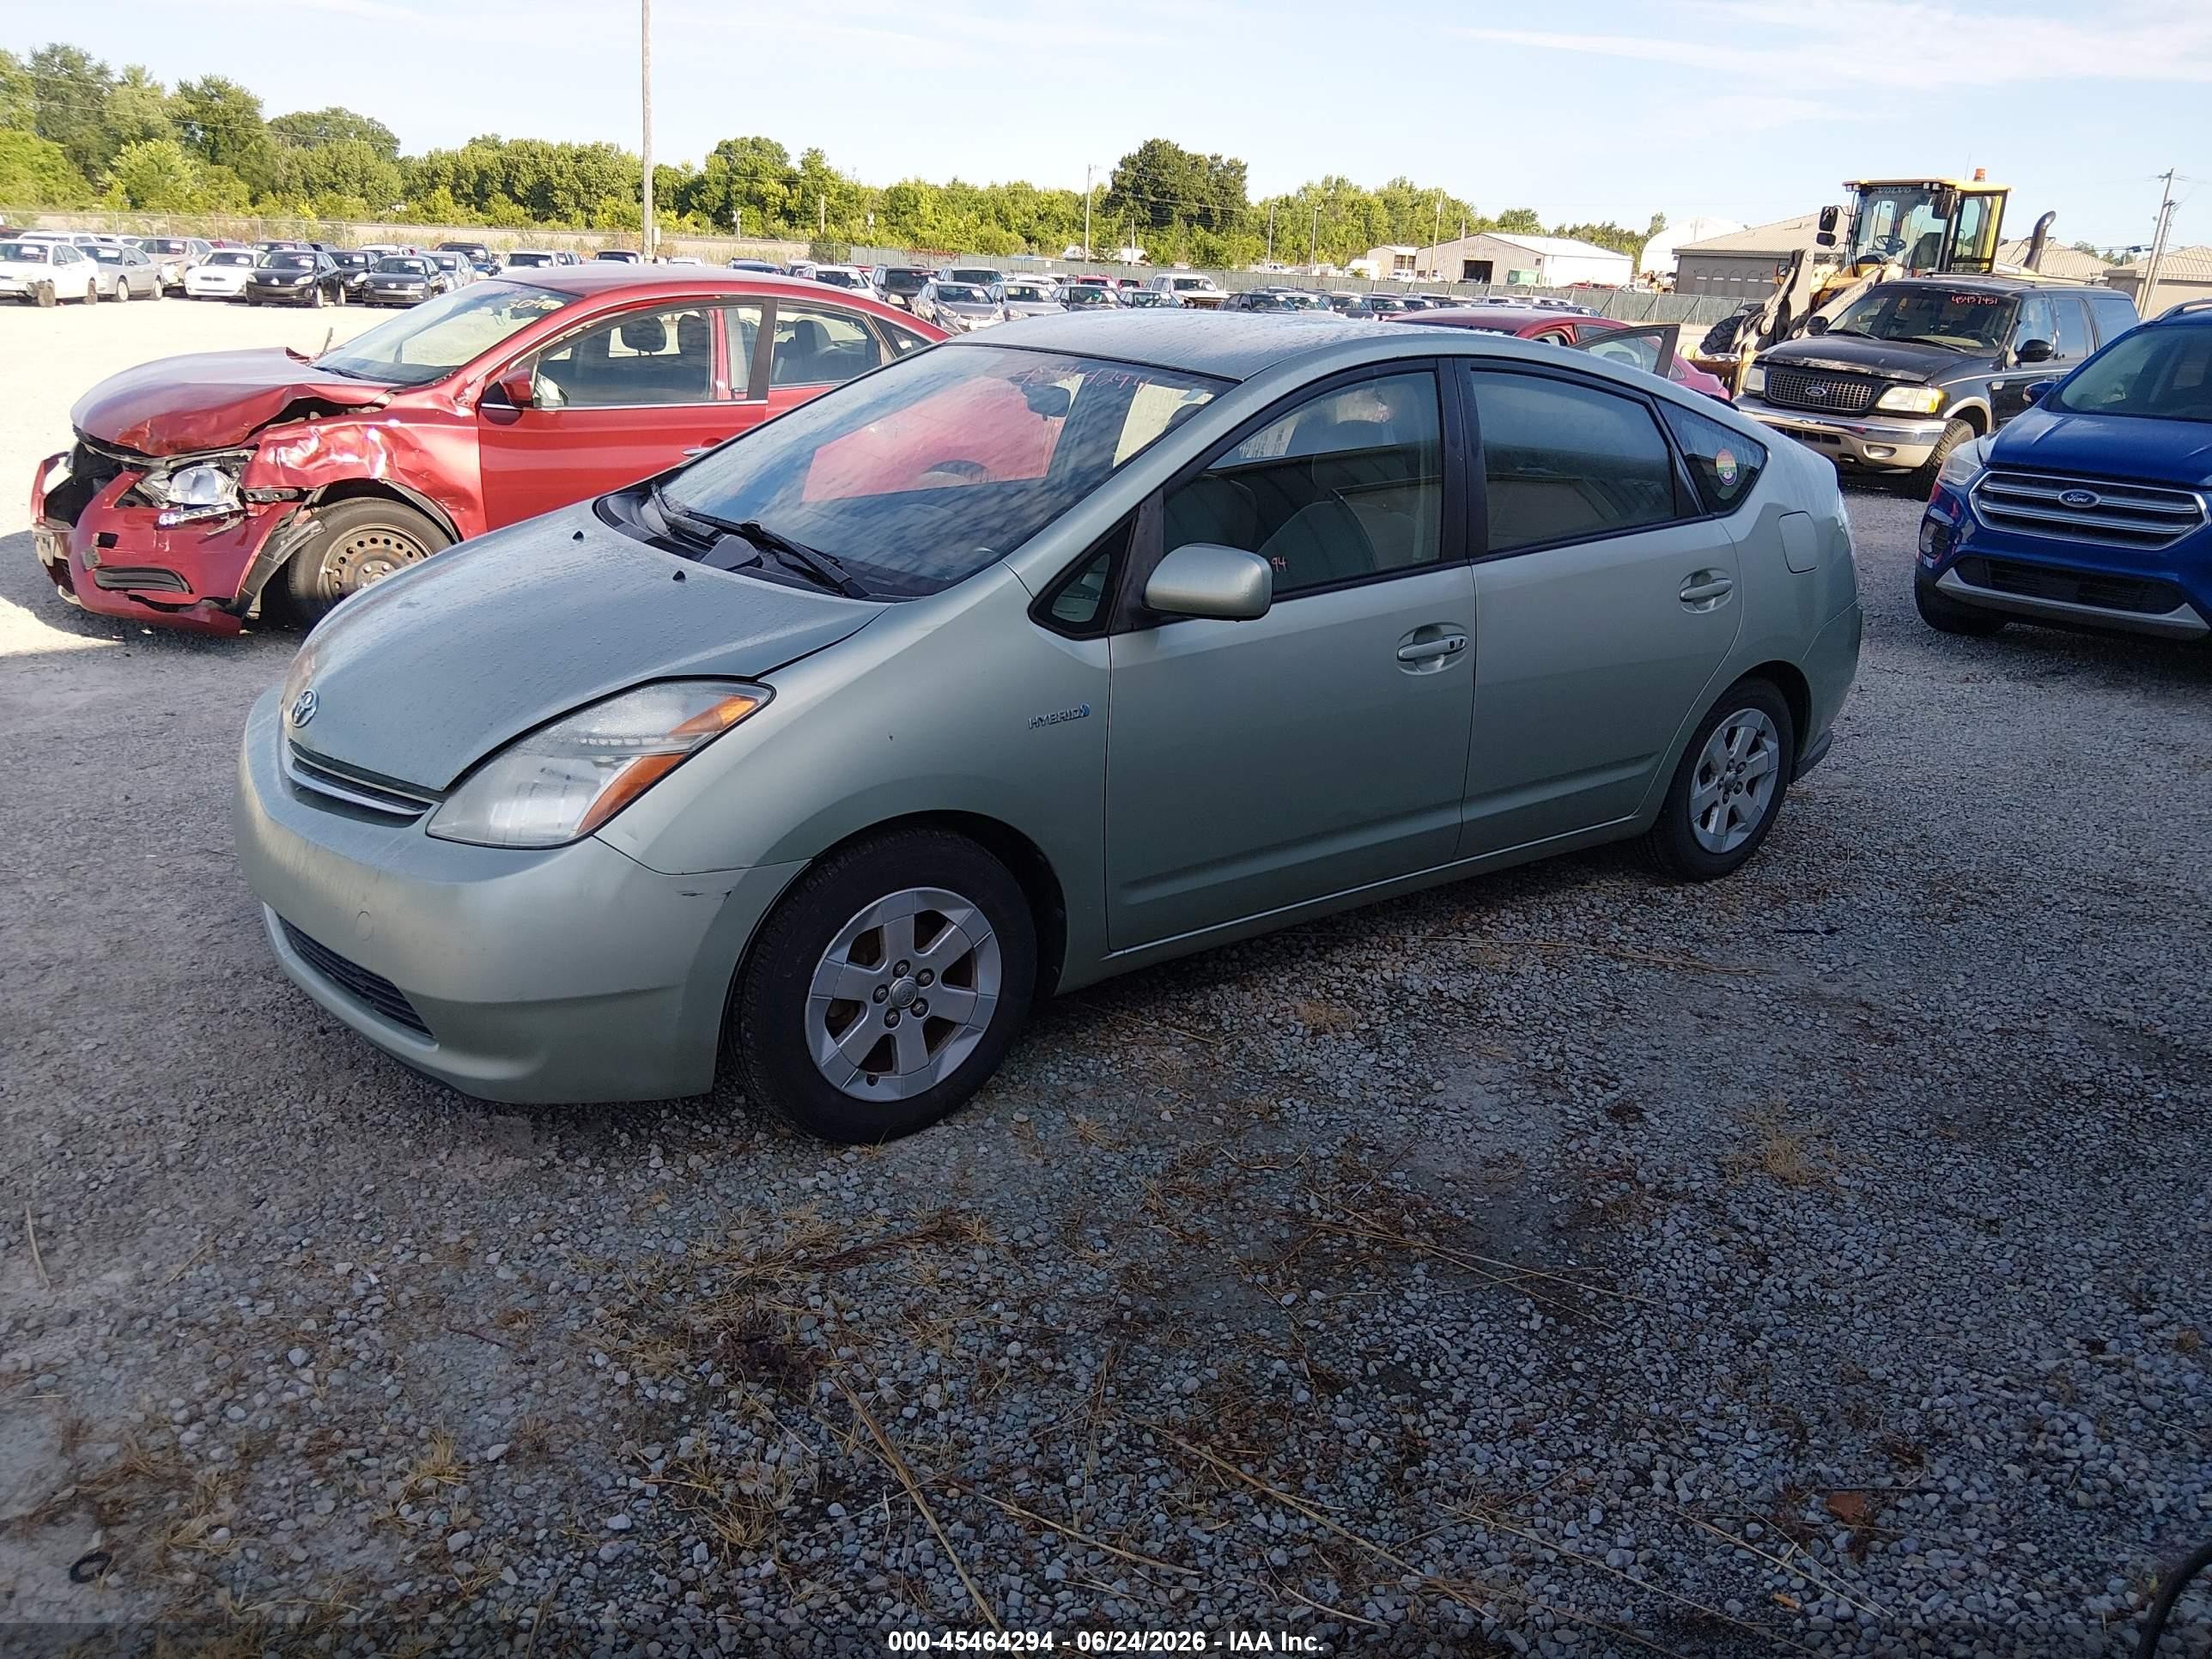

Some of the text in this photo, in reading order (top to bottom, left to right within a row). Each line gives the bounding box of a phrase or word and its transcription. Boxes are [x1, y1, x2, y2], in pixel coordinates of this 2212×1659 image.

[1877, 185, 1911, 194] VOLVO
[2067, 493, 2090, 503] Ford
[1271, 556, 1286, 572] 94
[1028, 708, 1081, 730] HYBRID
